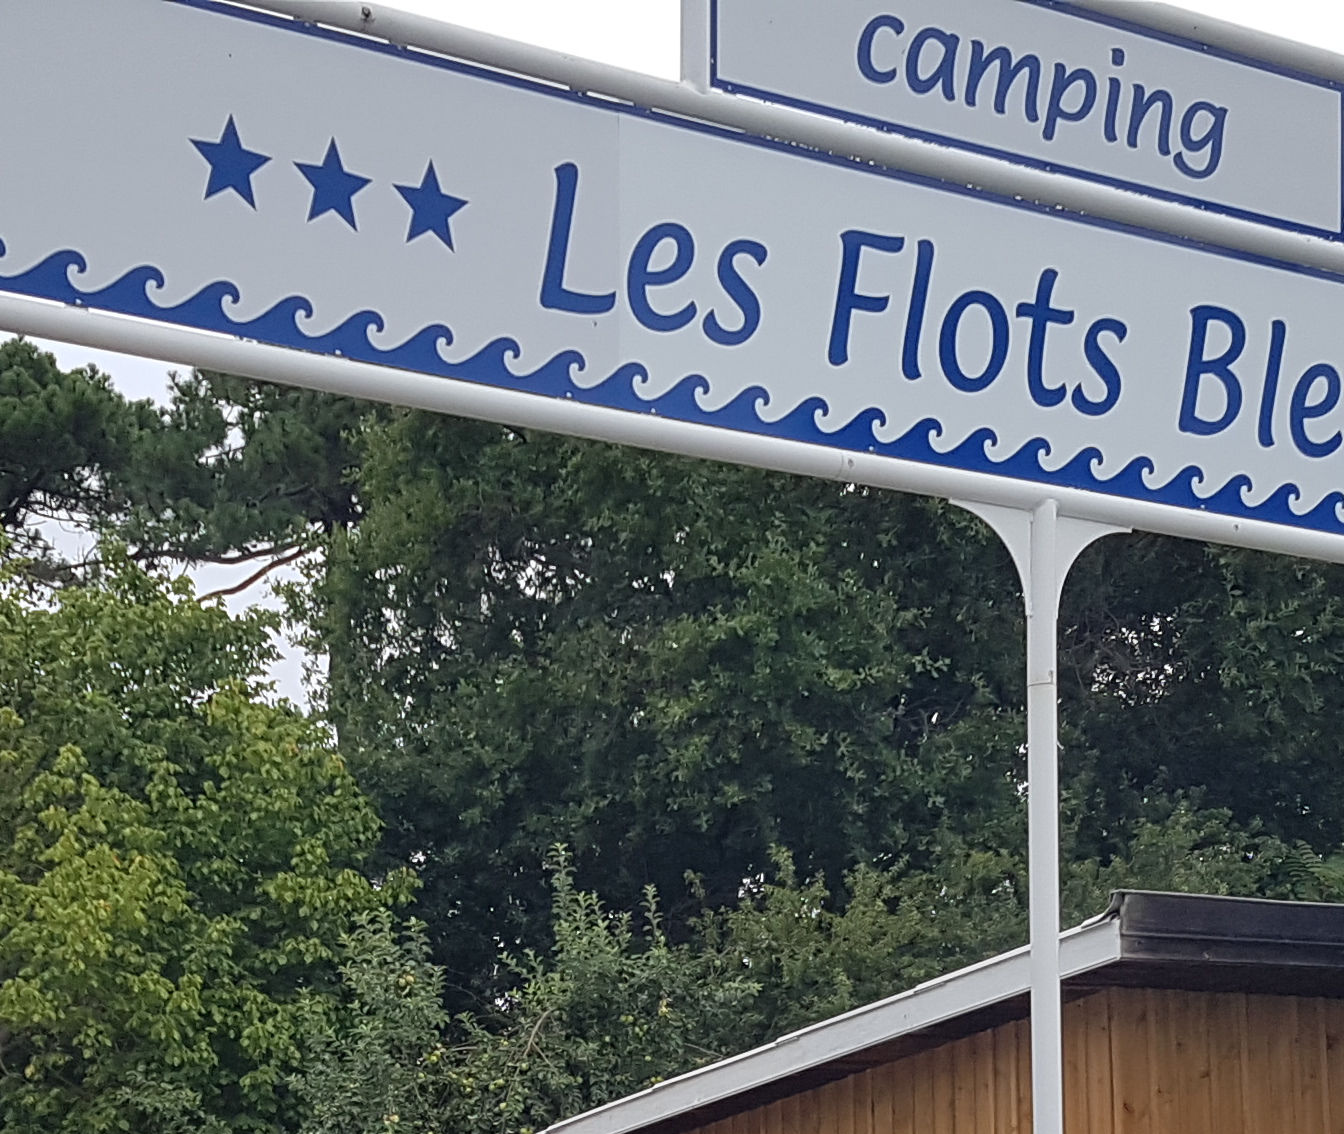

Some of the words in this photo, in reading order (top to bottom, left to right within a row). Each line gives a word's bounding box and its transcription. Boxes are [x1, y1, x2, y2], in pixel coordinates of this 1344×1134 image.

[857, 14, 1227, 179] camping
[540, 163, 768, 346] Les
[828, 230, 1127, 416] Flots
